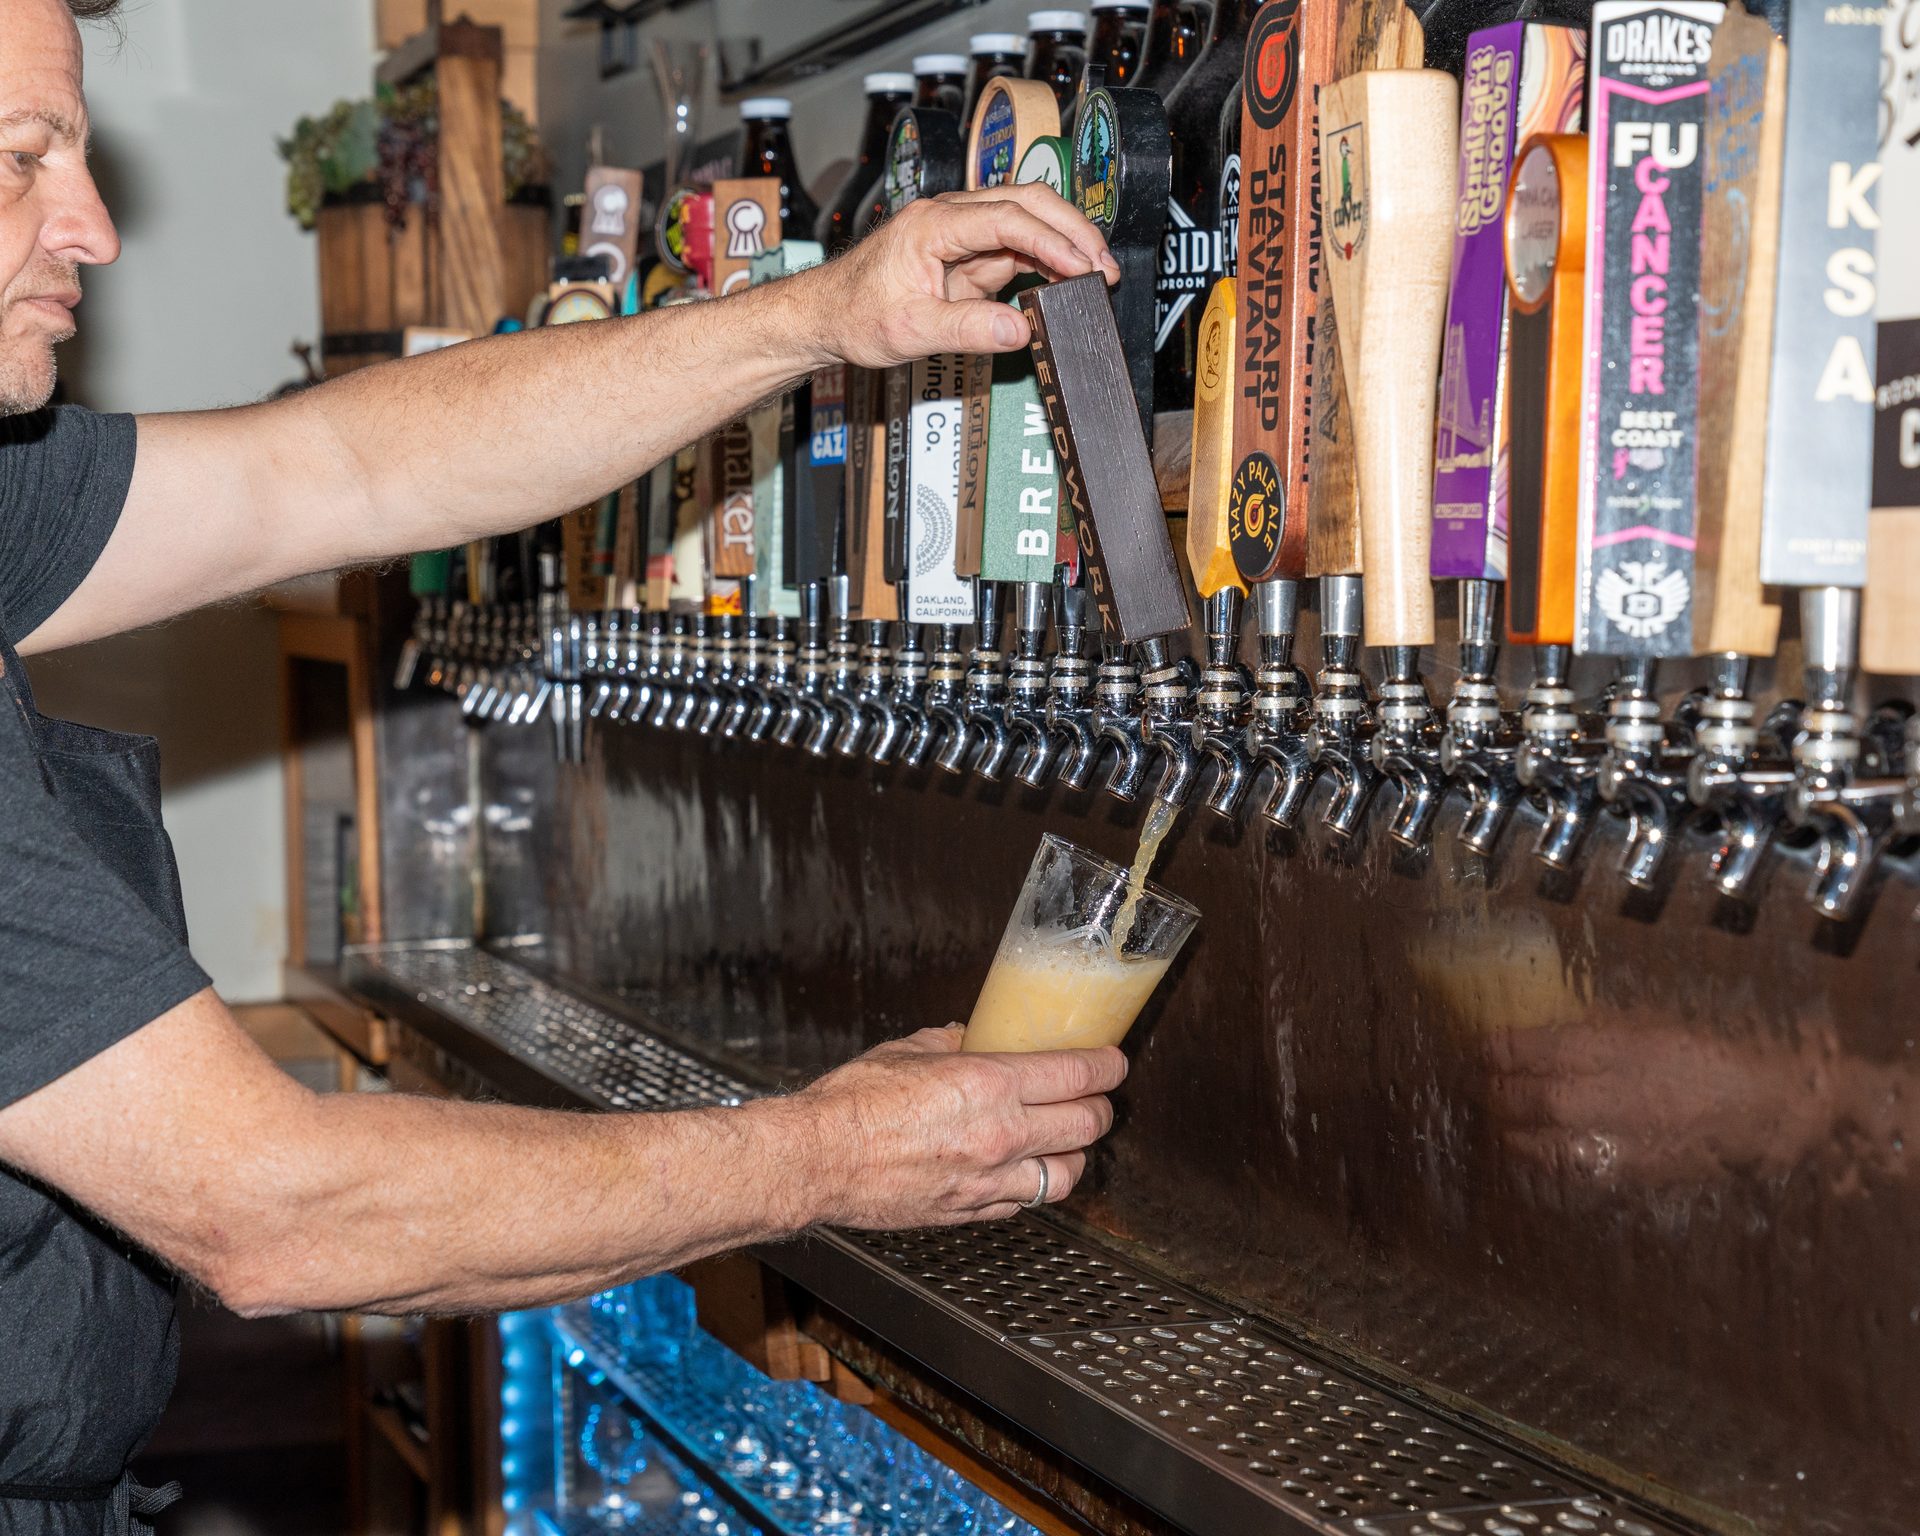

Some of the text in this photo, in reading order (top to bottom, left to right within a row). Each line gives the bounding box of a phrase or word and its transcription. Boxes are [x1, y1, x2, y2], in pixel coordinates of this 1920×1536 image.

[1459, 52, 1492, 228] Sunlight
[1613, 122, 1698, 168] FU
[1244, 170, 1267, 409] DEVIANT
[1262, 143, 1286, 431] STANDARD
[1629, 156, 1671, 394] CANCER
[926, 412, 946, 452] Co.
[1611, 429, 1684, 448] COAST
[1620, 411, 1677, 430] BEST
[1023, 307, 1110, 633] FIELDWORK
[1231, 460, 1279, 552] HAZY PALE ALE
[916, 595, 967, 605] OAKLAND,
[916, 608, 974, 616] CALIFORNIA
